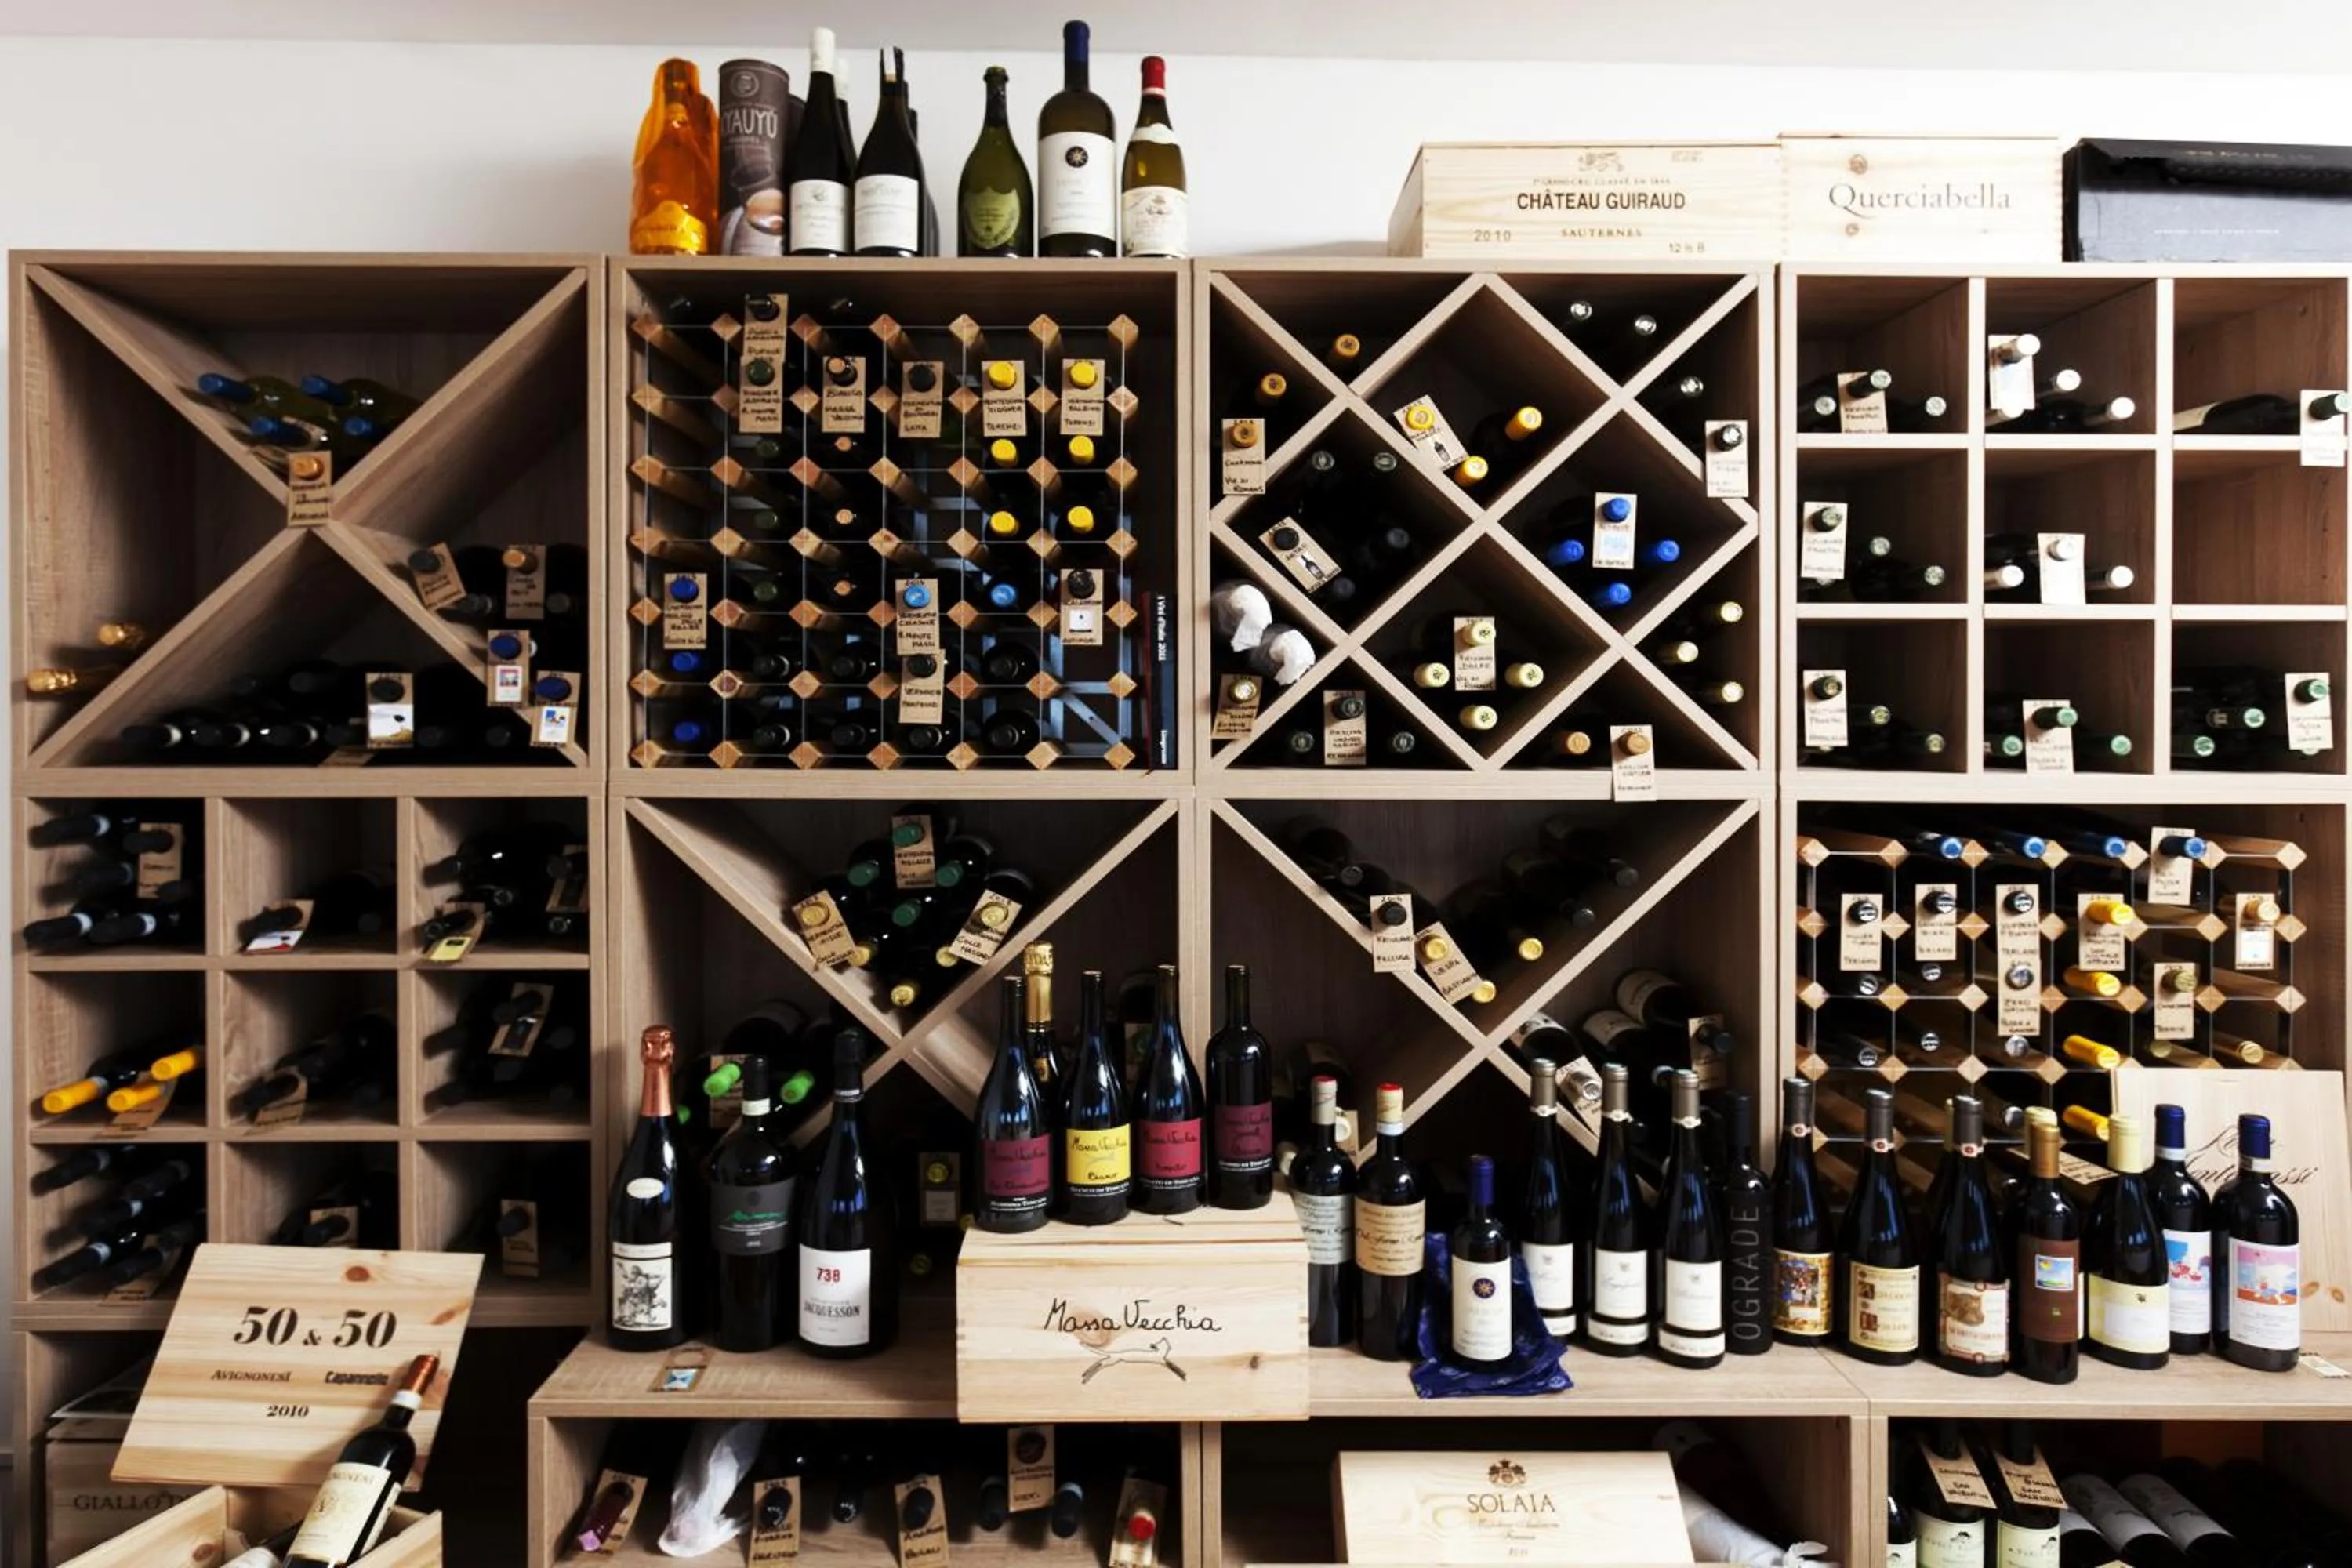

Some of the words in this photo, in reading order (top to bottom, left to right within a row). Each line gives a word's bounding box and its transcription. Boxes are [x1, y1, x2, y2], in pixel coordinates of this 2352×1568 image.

[1516, 189, 1600, 210] CHÂTEAU
[1606, 192, 1686, 210] GUIRAUD
[1828, 182, 2011, 220] Querciabella
[1474, 229, 1512, 243] 2010
[1561, 228, 1642, 237] SAUTERNES
[815, 1266, 841, 1283] 738
[1730, 1206, 1762, 1341] OGRADE
[1044, 1298, 1121, 1332] Massa
[1124, 1299, 1223, 1332] Vecchia
[234, 1306, 299, 1345] 50
[303, 1329, 322, 1346] &
[333, 1309, 397, 1348] 50
[211, 1369, 292, 1382] AVIGNONESI
[267, 1404, 310, 1418] 2010
[73, 1494, 161, 1511] GIALLO
[1466, 1493, 1556, 1514] SOLAIA
